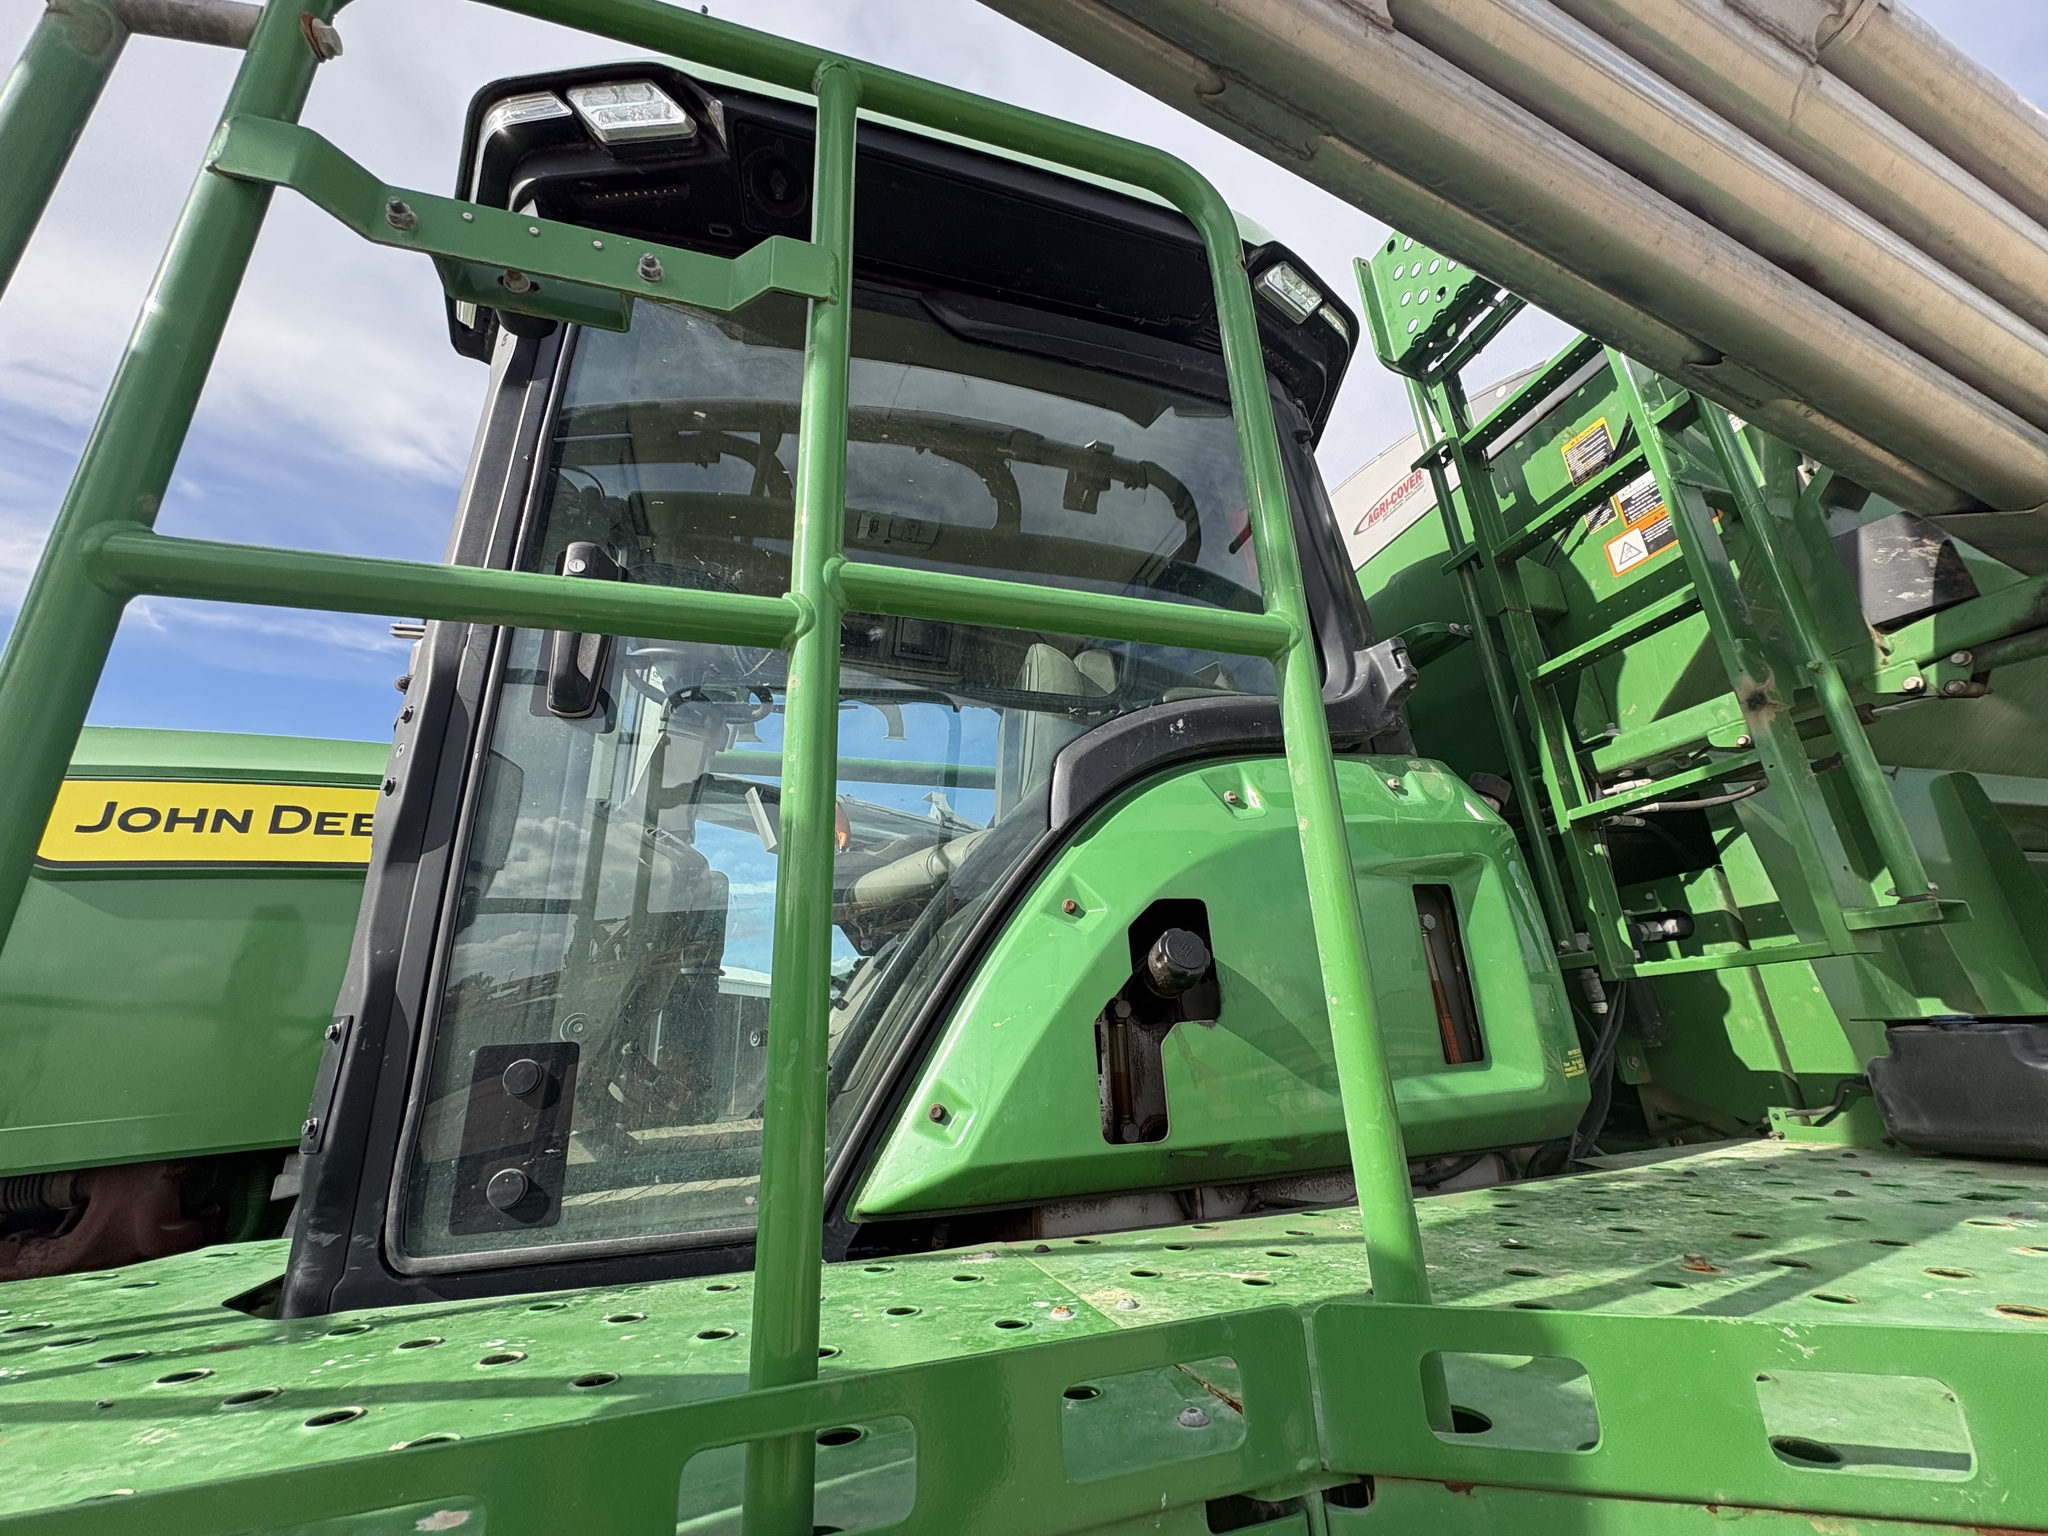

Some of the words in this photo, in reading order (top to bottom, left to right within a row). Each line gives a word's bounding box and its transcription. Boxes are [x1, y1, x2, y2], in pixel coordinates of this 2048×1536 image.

[1367, 469, 1423, 527] AGRI-COVER
[74, 801, 254, 834] JOHN
[268, 804, 374, 836] DEE
